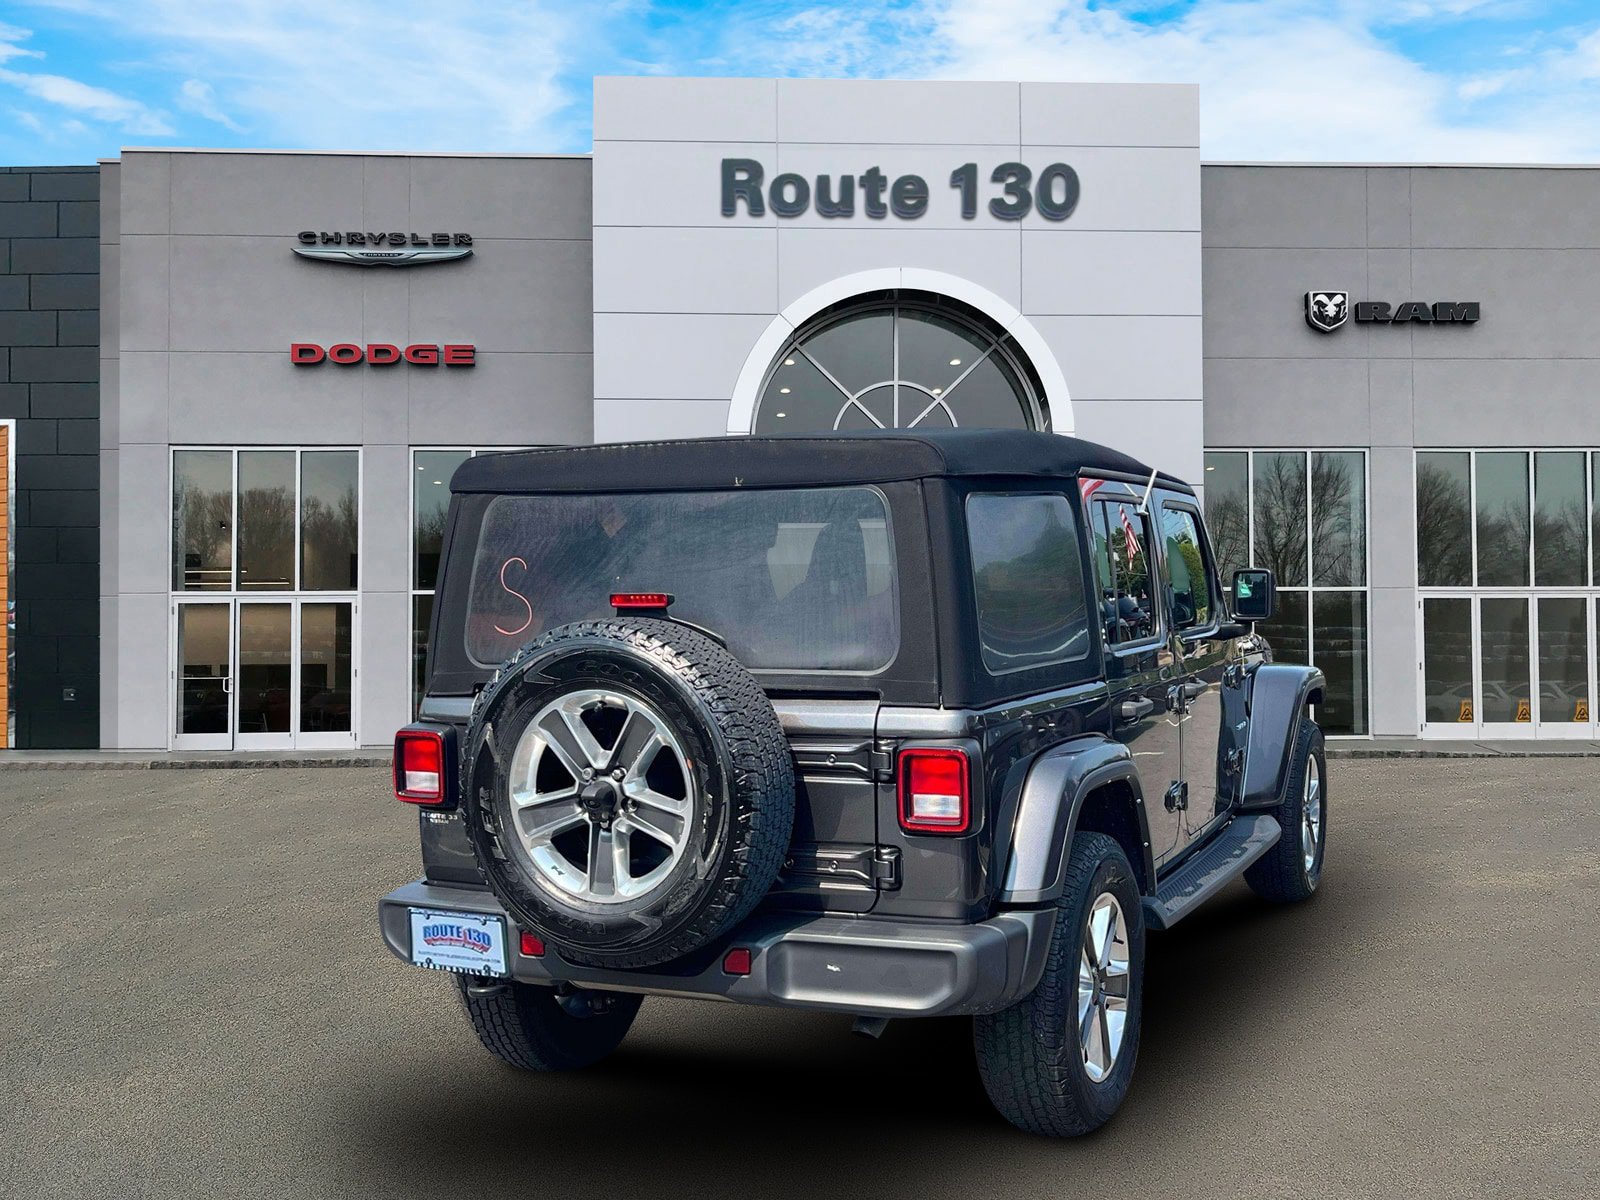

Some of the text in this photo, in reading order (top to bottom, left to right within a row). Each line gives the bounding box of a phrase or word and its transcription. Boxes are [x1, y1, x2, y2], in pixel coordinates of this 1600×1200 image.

[720, 157, 1081, 221] Route 130
[297, 231, 473, 246] CHRYSLER
[1354, 301, 1481, 325] RAM
[290, 343, 476, 366] DODGE
[494, 556, 533, 635] S
[423, 923, 463, 939] ROUTE
[466, 927, 492, 947] 130
